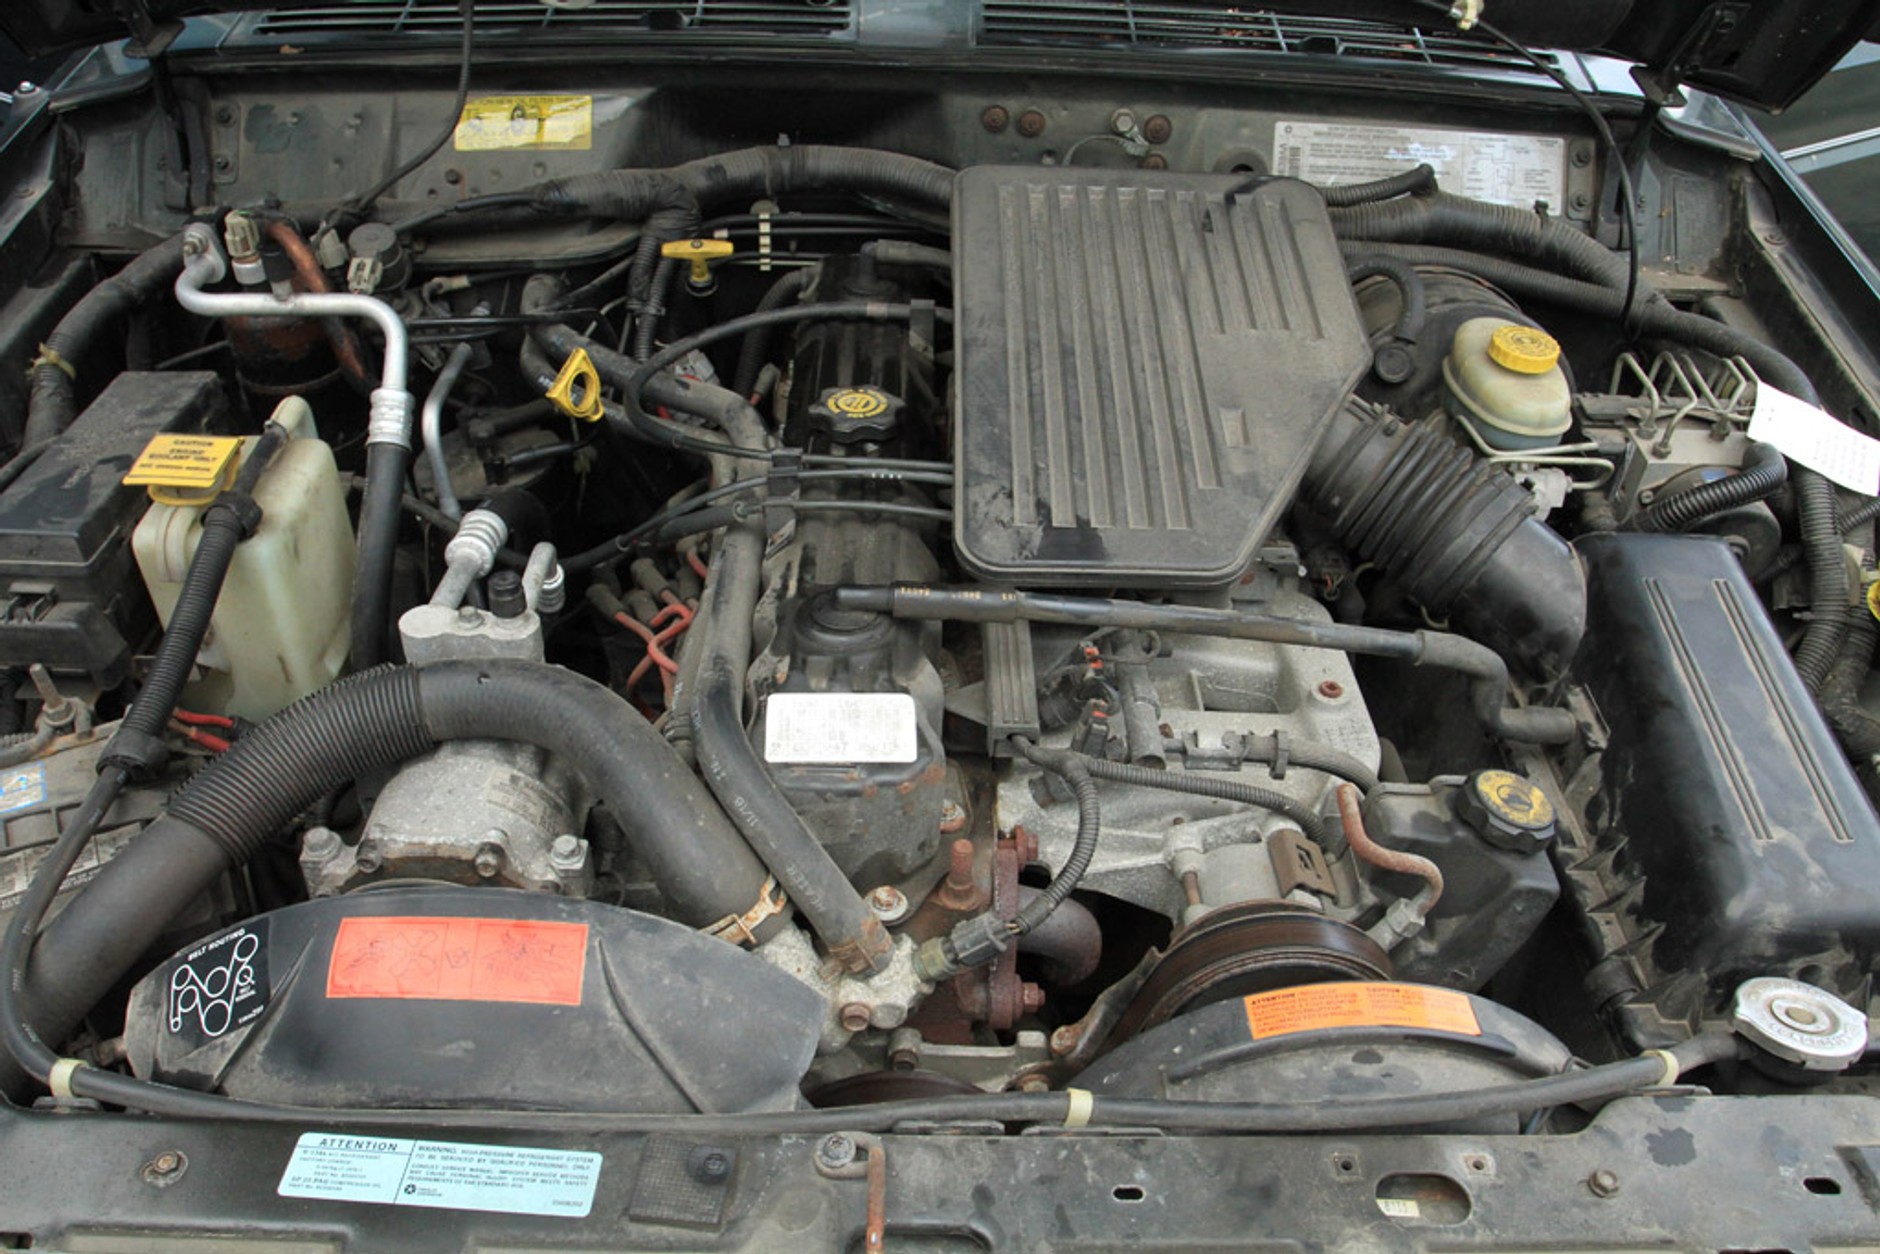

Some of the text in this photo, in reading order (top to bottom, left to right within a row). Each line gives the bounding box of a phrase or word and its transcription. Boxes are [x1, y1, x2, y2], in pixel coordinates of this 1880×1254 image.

[785, 863, 827, 913] HEATER
[187, 928, 246, 961] BELT ROUTING
[1251, 993, 1296, 1006] ATTENTION
[319, 1138, 399, 1151] ATTENTION
